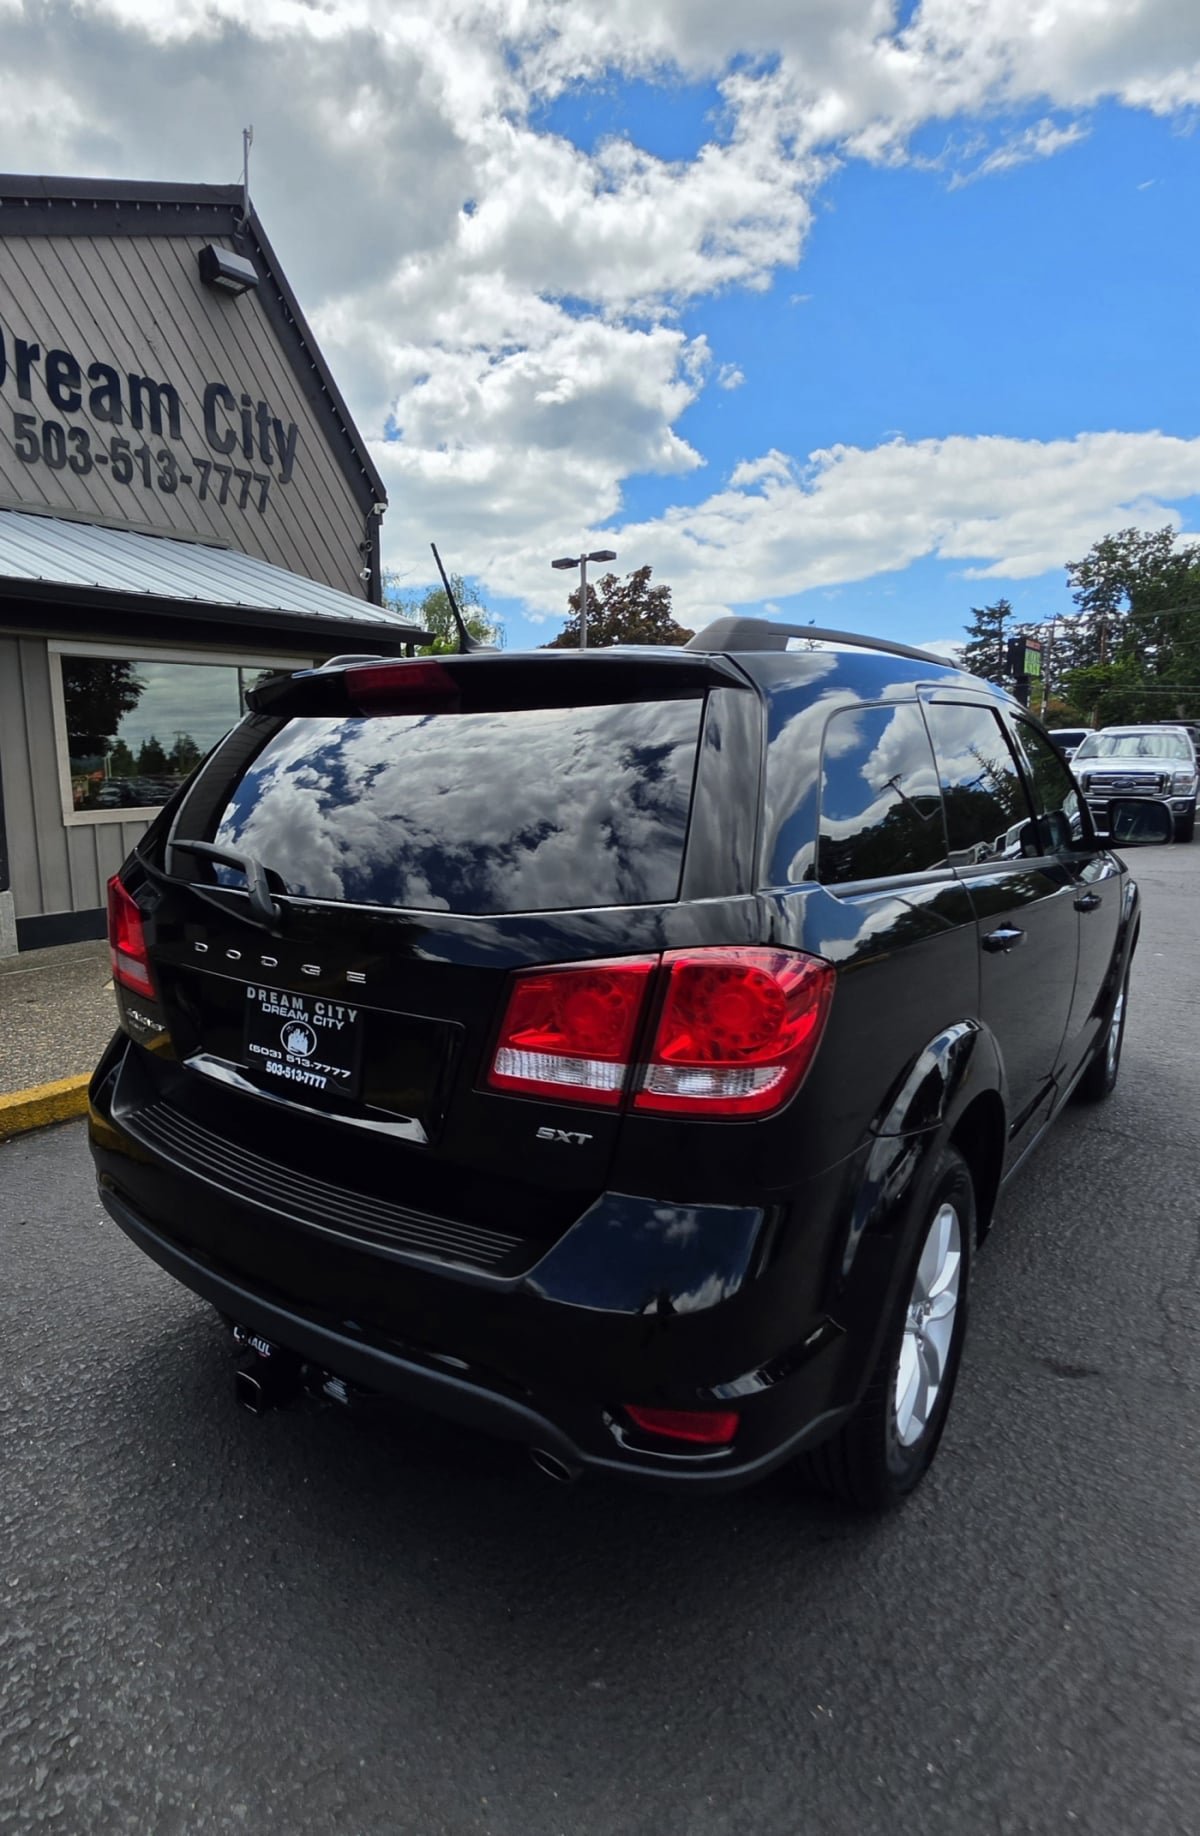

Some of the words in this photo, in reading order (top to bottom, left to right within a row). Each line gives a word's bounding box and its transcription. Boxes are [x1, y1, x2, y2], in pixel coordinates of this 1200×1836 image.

[0, 325, 181, 440] ream
[203, 382, 297, 484] City
[13, 412, 270, 513] 503-513-7777
[194, 941, 367, 985] DODGE
[246, 986, 304, 1010] DREAM
[314, 1001, 358, 1023] CITY
[261, 1002, 309, 1022] DREAM
[312, 1014, 345, 1031] CITY
[248, 1043, 283, 1060] (503)
[285, 1054, 352, 1079] 513-7777
[265, 1060, 327, 1090] 503-513-7777
[535, 1126, 594, 1145] SXT
